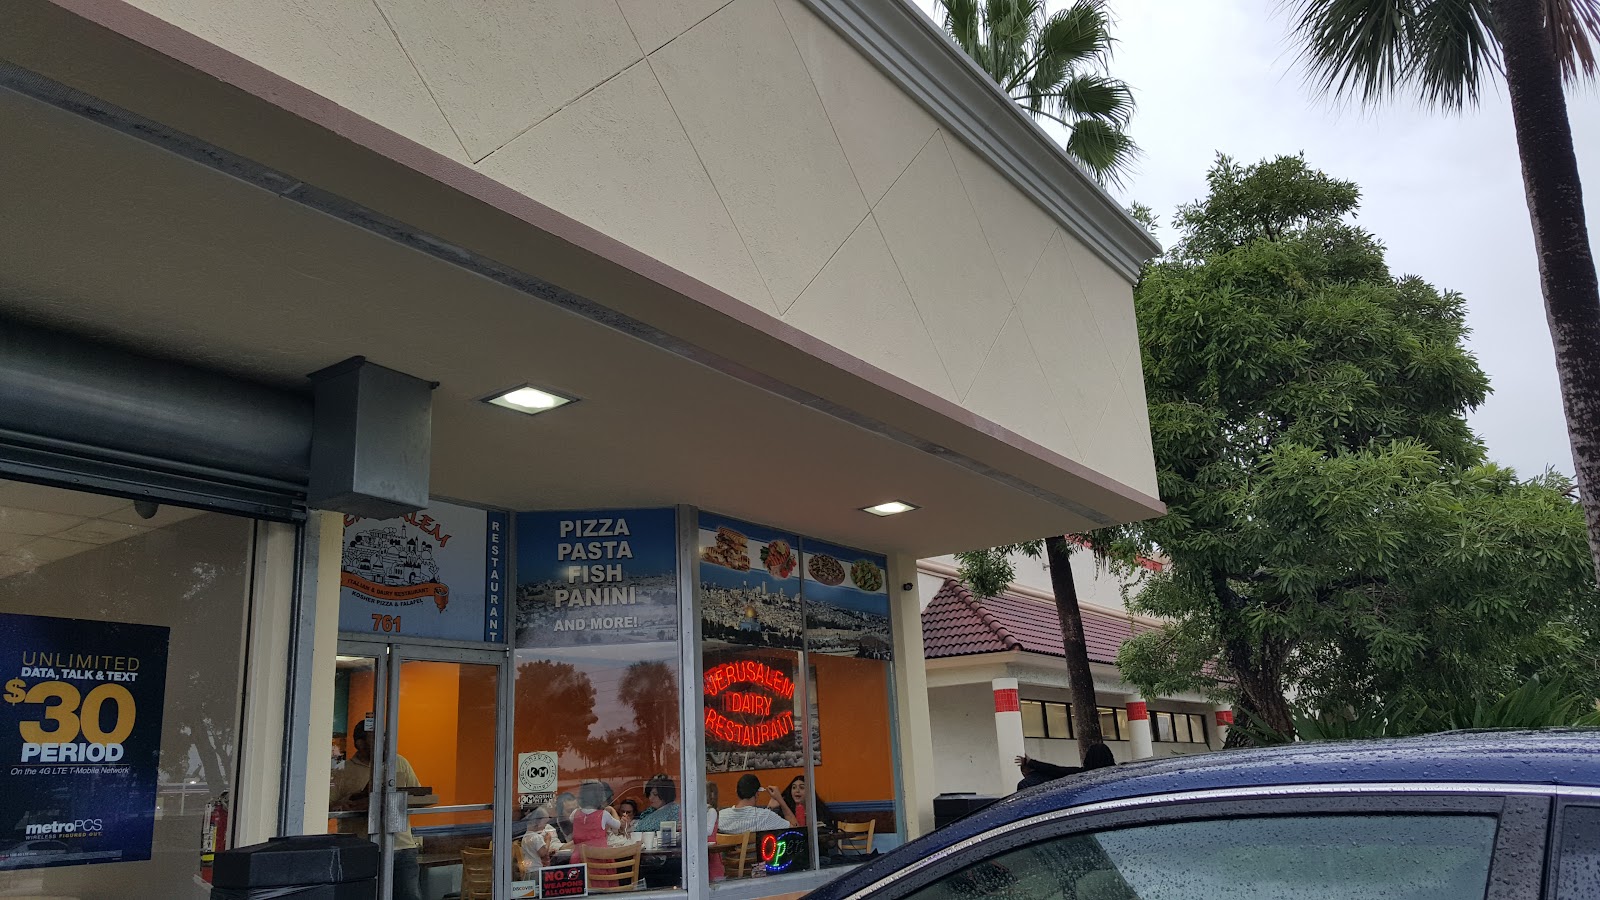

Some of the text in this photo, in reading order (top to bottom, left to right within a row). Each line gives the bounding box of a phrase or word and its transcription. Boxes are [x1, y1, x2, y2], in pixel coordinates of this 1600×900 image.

[560, 518, 630, 538] PIZZA
[557, 541, 633, 561] PASTA
[489, 521, 500, 642] RESTAURANT
[568, 563, 623, 584] FISH
[347, 578, 371, 592] ITALIAN
[376, 589, 393, 597] DAIRY
[394, 587, 429, 597] RESTAURANT
[555, 586, 636, 608] PANINI
[351, 590, 375, 603] KOSHER
[376, 599, 394, 607] PIZZA
[400, 598, 424, 607] FALAFEL
[371, 613, 401, 632] 761
[553, 616, 638, 632] AND MORE!
[22, 651, 140, 671] UNLIMITED
[21, 666, 138, 682] DATA, TALK & TEXT
[706, 661, 796, 700] JERUSALEM
[3, 676, 137, 747] $30
[732, 692, 772, 716] DAIRY
[704, 708, 795, 747] RESTAURANT
[20, 742, 124, 763] PERIOD
[10, 766, 130, 776] On the 4G LTE T-Mobile Network
[25, 818, 103, 835] metroPCS
[543, 880, 583, 889] WEAPONS
[544, 870, 565, 881] NO
[545, 887, 583, 896] ALLOWED
